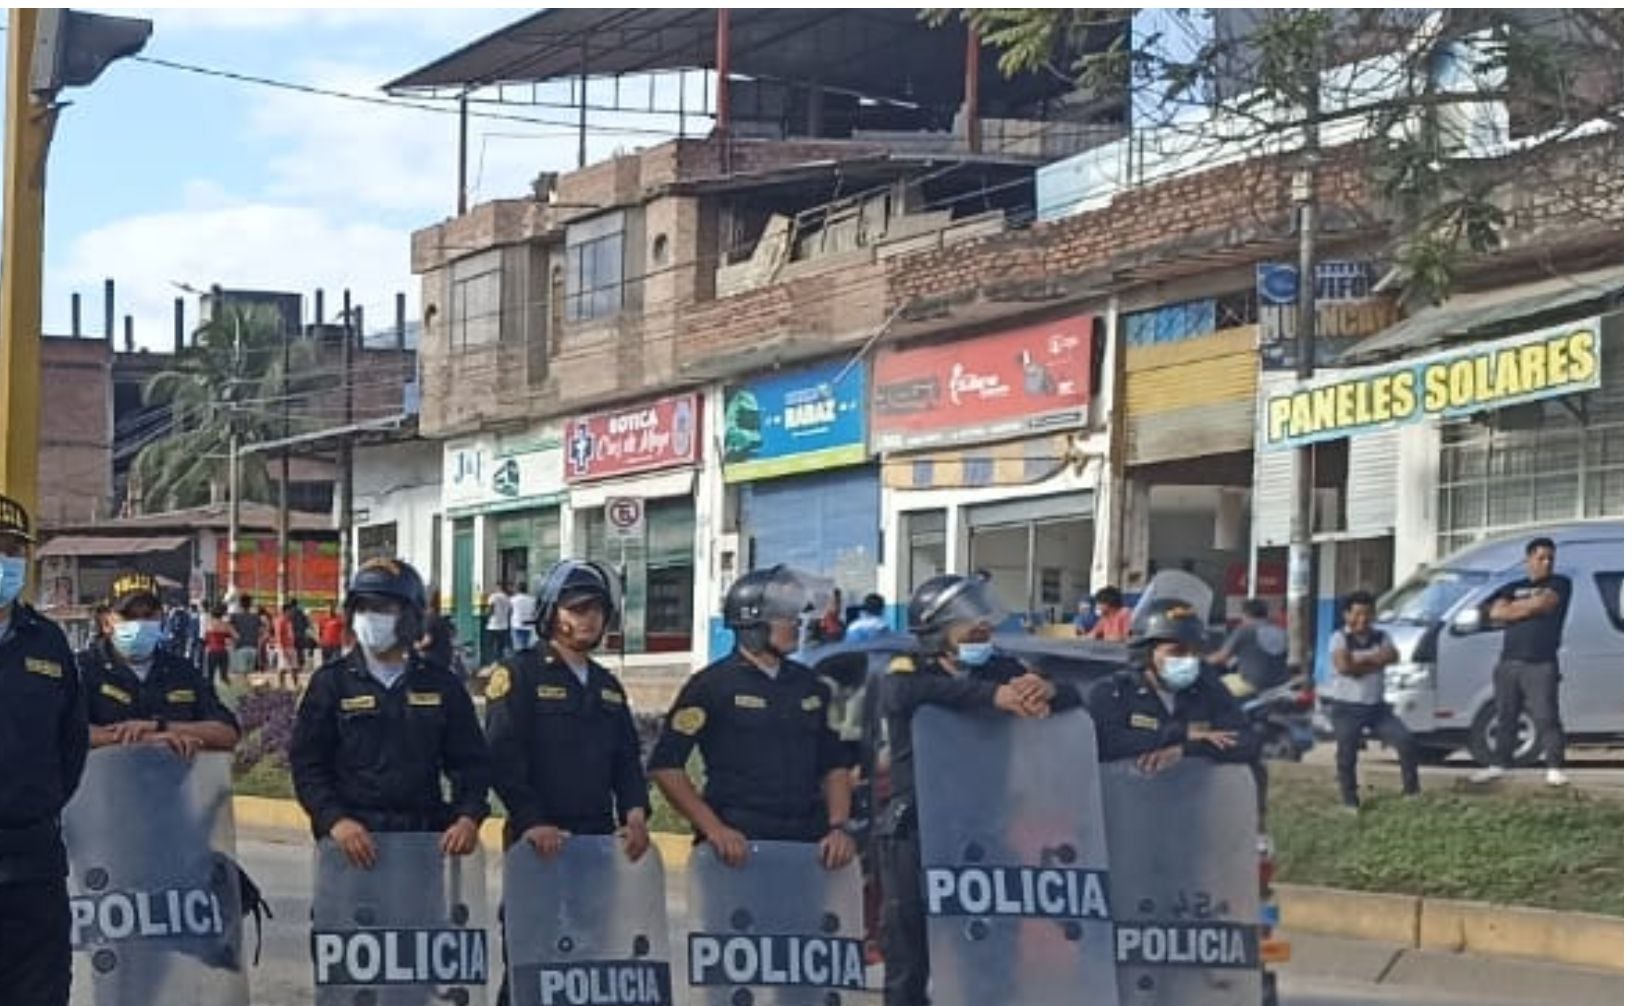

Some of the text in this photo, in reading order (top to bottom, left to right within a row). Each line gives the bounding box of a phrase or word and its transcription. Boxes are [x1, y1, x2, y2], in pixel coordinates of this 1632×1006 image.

[1268, 330, 1595, 442] PANELES SOLARES
[609, 409, 658, 433] BOTICA
[928, 868, 1109, 919] POLICIA
[316, 933, 488, 984] POLICIA
[692, 936, 867, 988] POLICIA
[1117, 926, 1248, 964] POLICIA
[540, 966, 660, 1005] POLICIA
